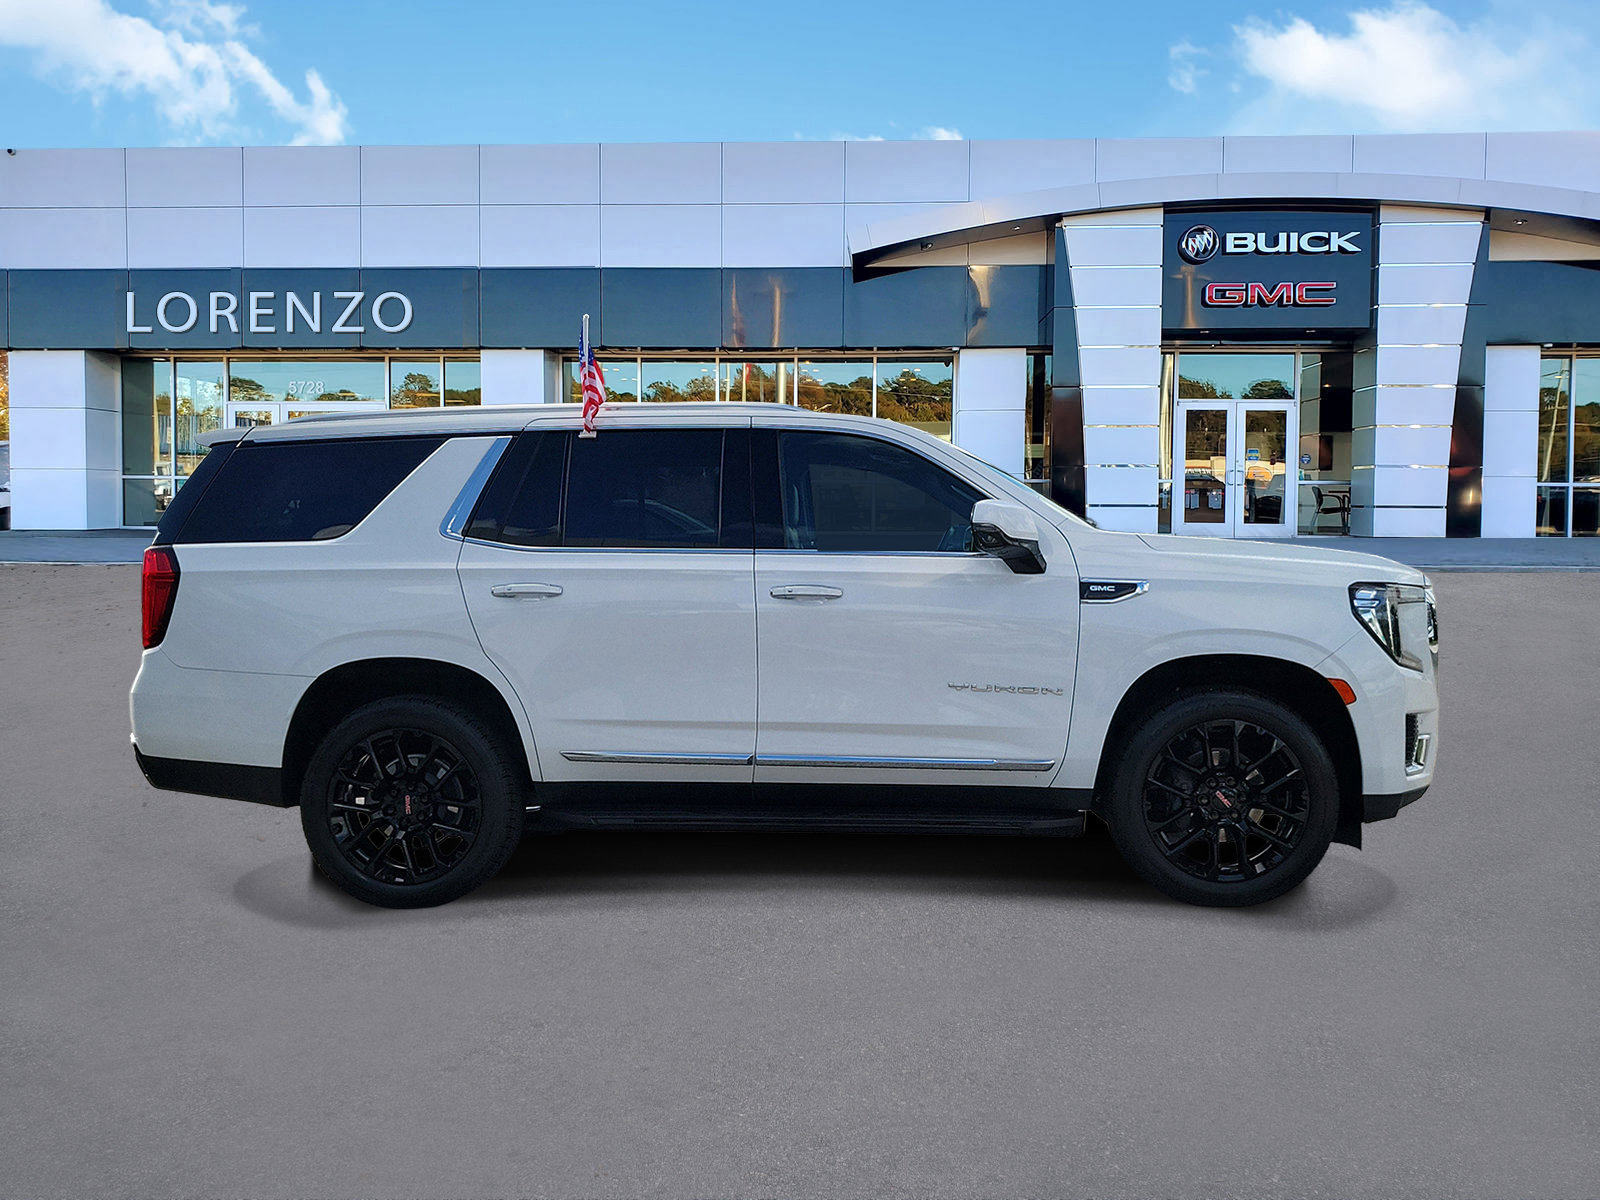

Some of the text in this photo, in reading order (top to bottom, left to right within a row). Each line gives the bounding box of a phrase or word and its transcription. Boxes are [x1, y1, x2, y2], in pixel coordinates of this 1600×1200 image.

[1225, 231, 1362, 253] BUICK
[1206, 282, 1337, 306] GMC
[126, 291, 414, 333] LORENZO
[288, 380, 325, 395] 5728
[948, 682, 1064, 696] YUKON
